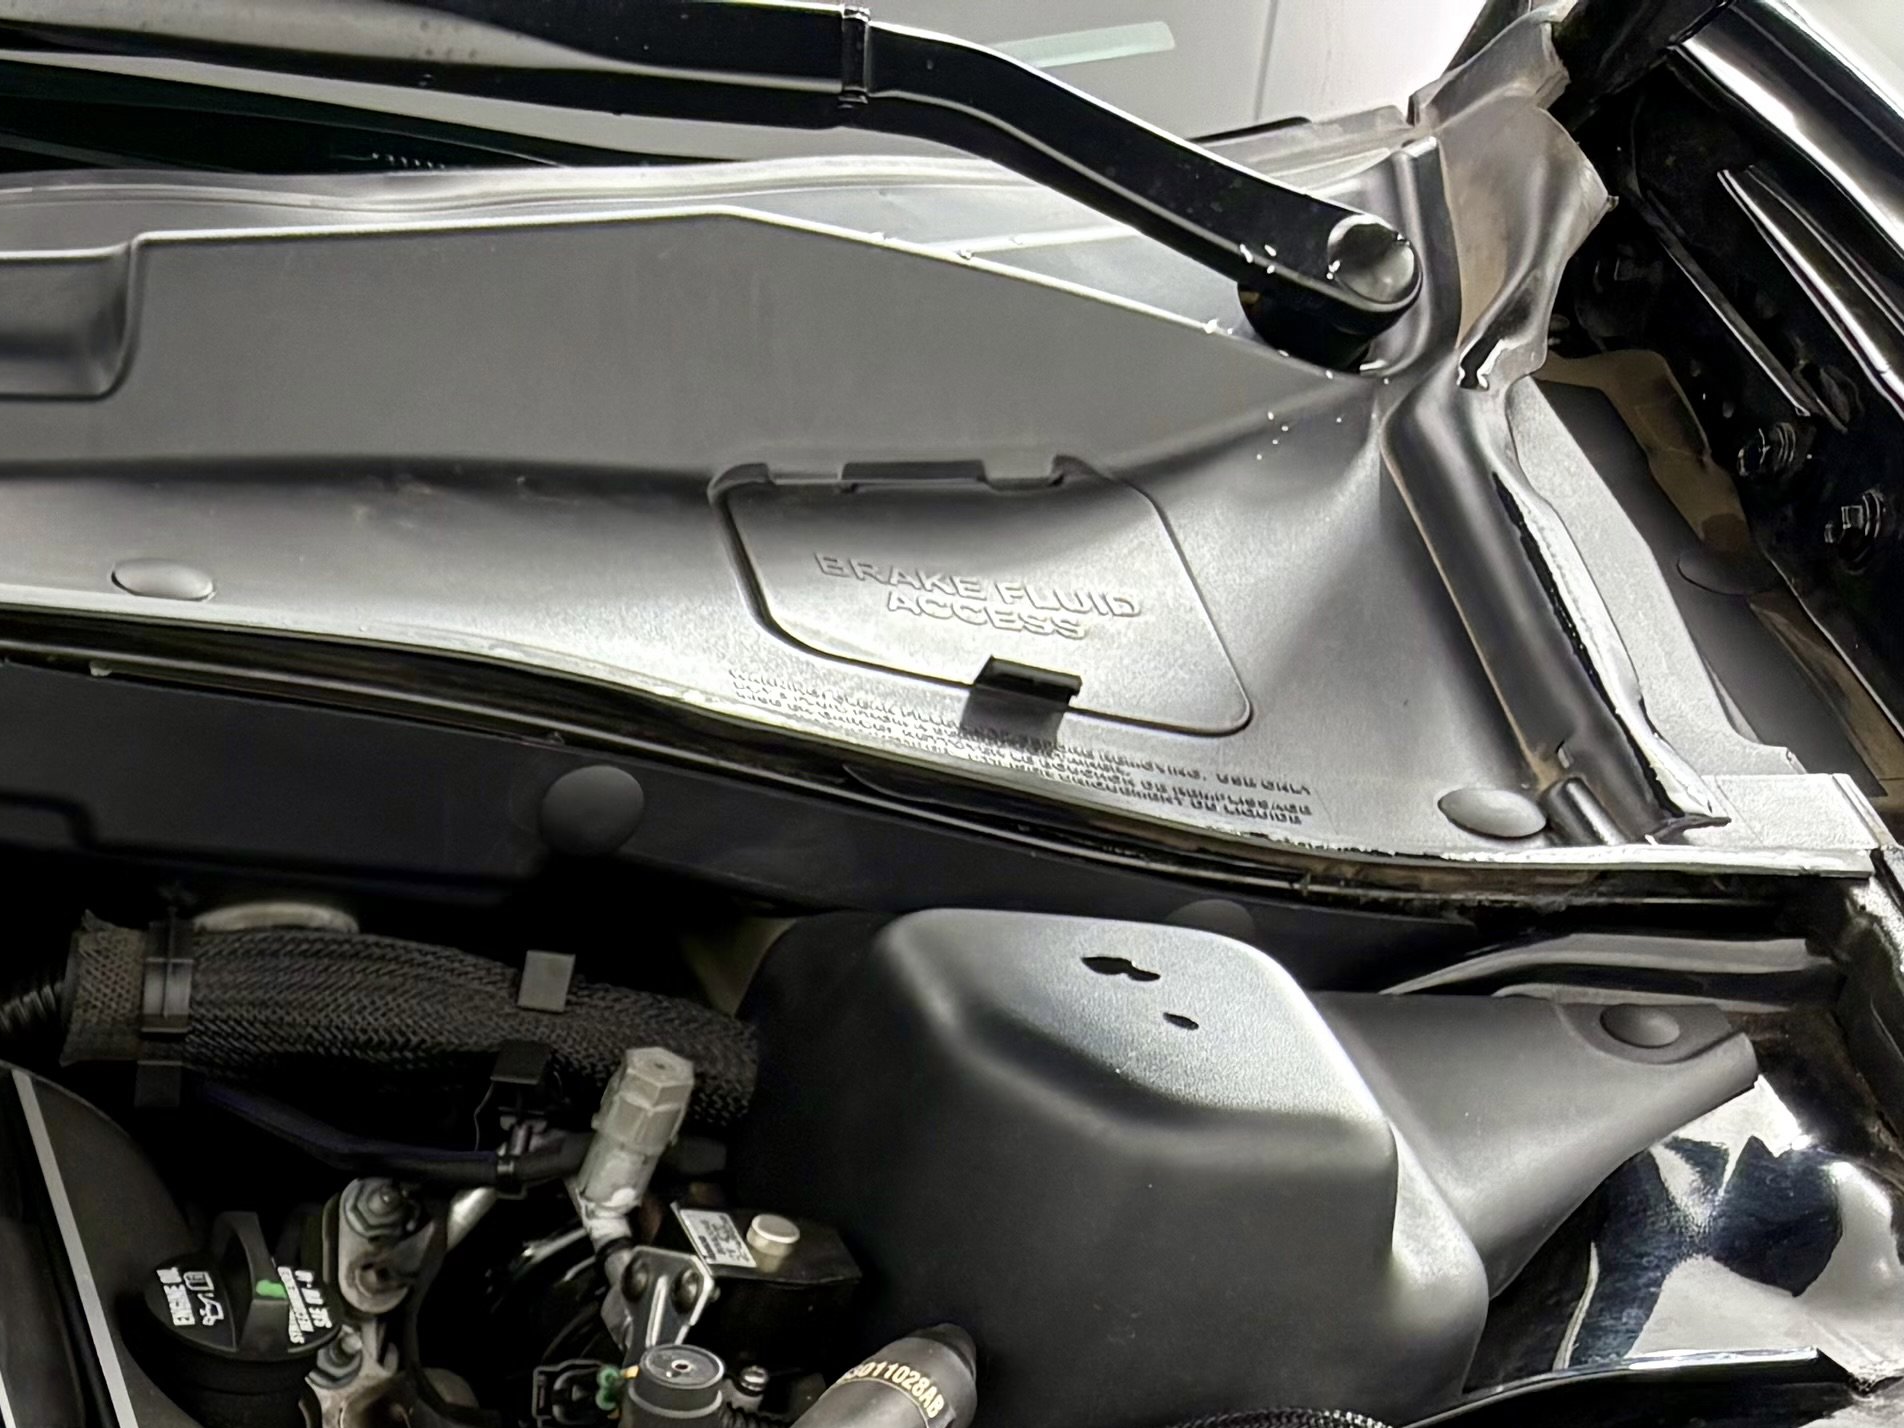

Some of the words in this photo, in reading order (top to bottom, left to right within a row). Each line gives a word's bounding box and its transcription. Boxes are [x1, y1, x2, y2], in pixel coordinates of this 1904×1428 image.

[814, 553, 989, 601] BRAKE
[993, 582, 1141, 617] FLUID
[888, 591, 1090, 640] ACCESS
